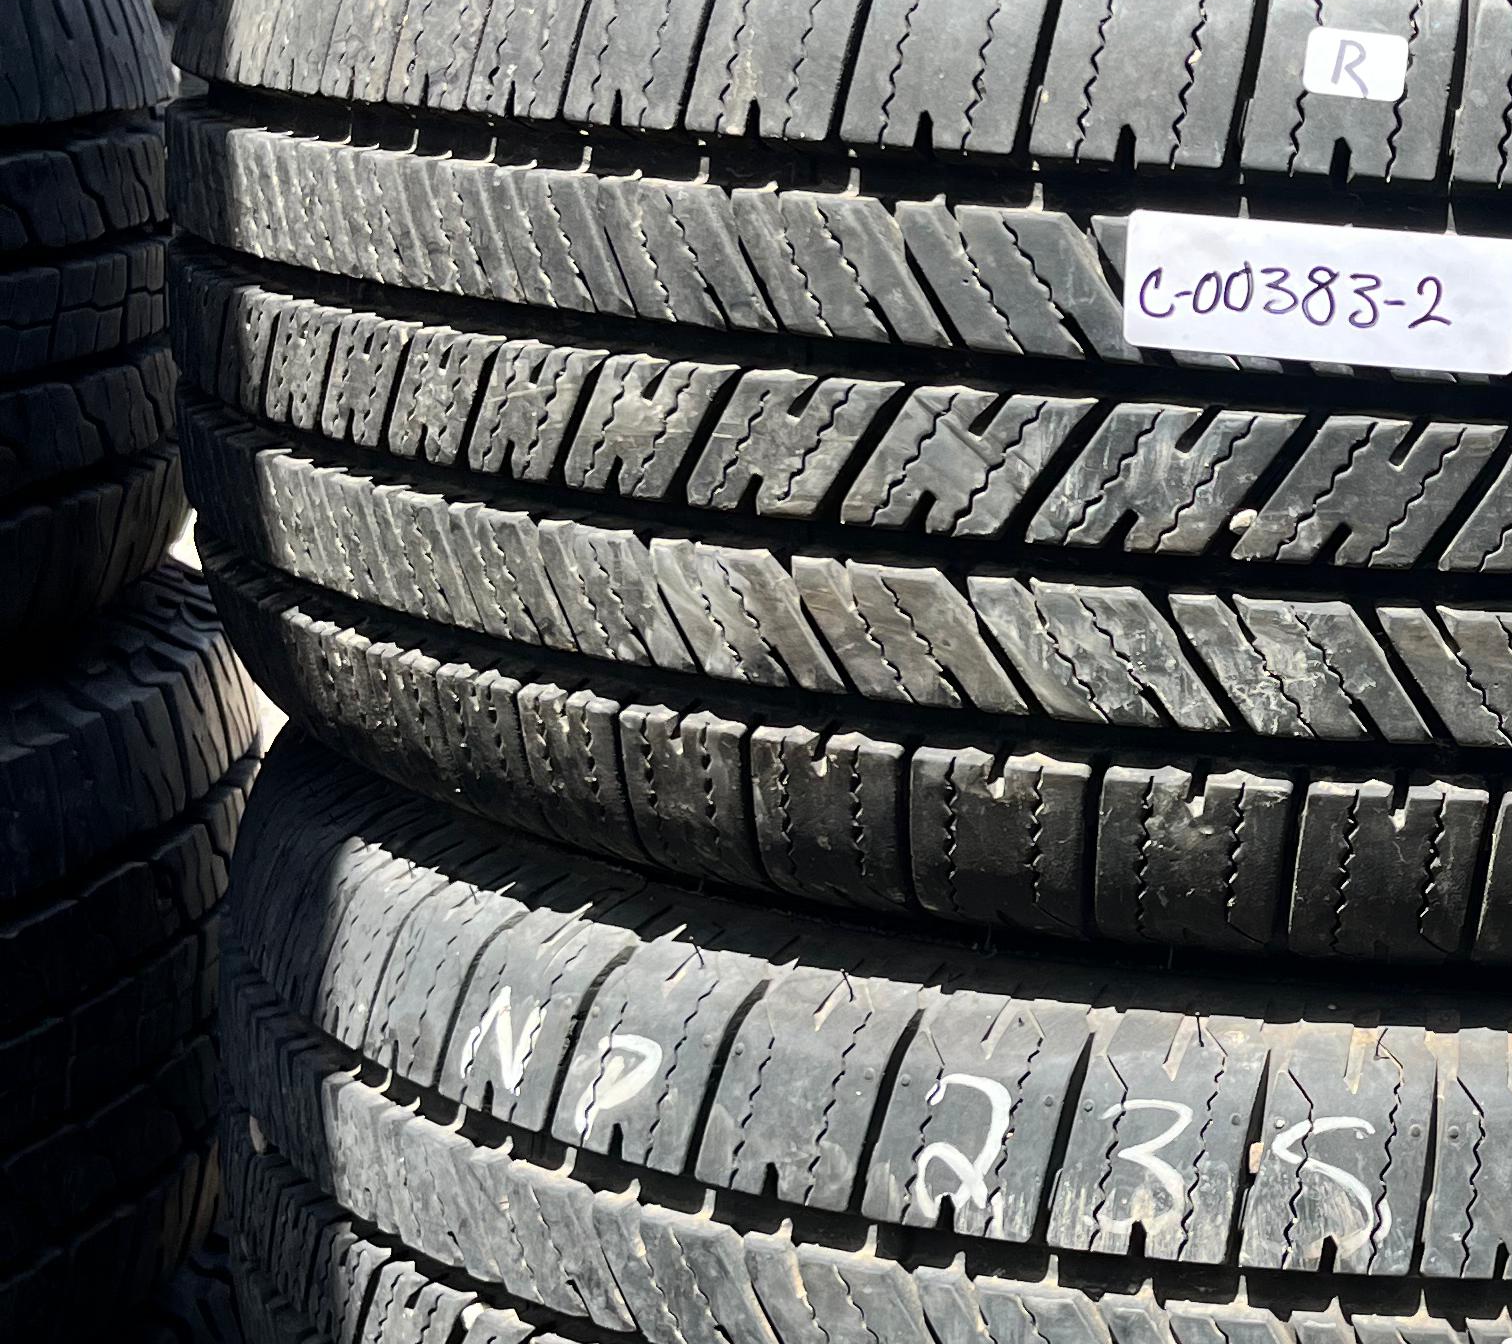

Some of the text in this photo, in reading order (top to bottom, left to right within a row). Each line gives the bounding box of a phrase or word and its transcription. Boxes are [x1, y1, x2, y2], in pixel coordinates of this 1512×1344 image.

[1331, 39, 1370, 98] R
[1140, 262, 1452, 329] C-00383-2
[914, 1073, 1391, 1260] 235
